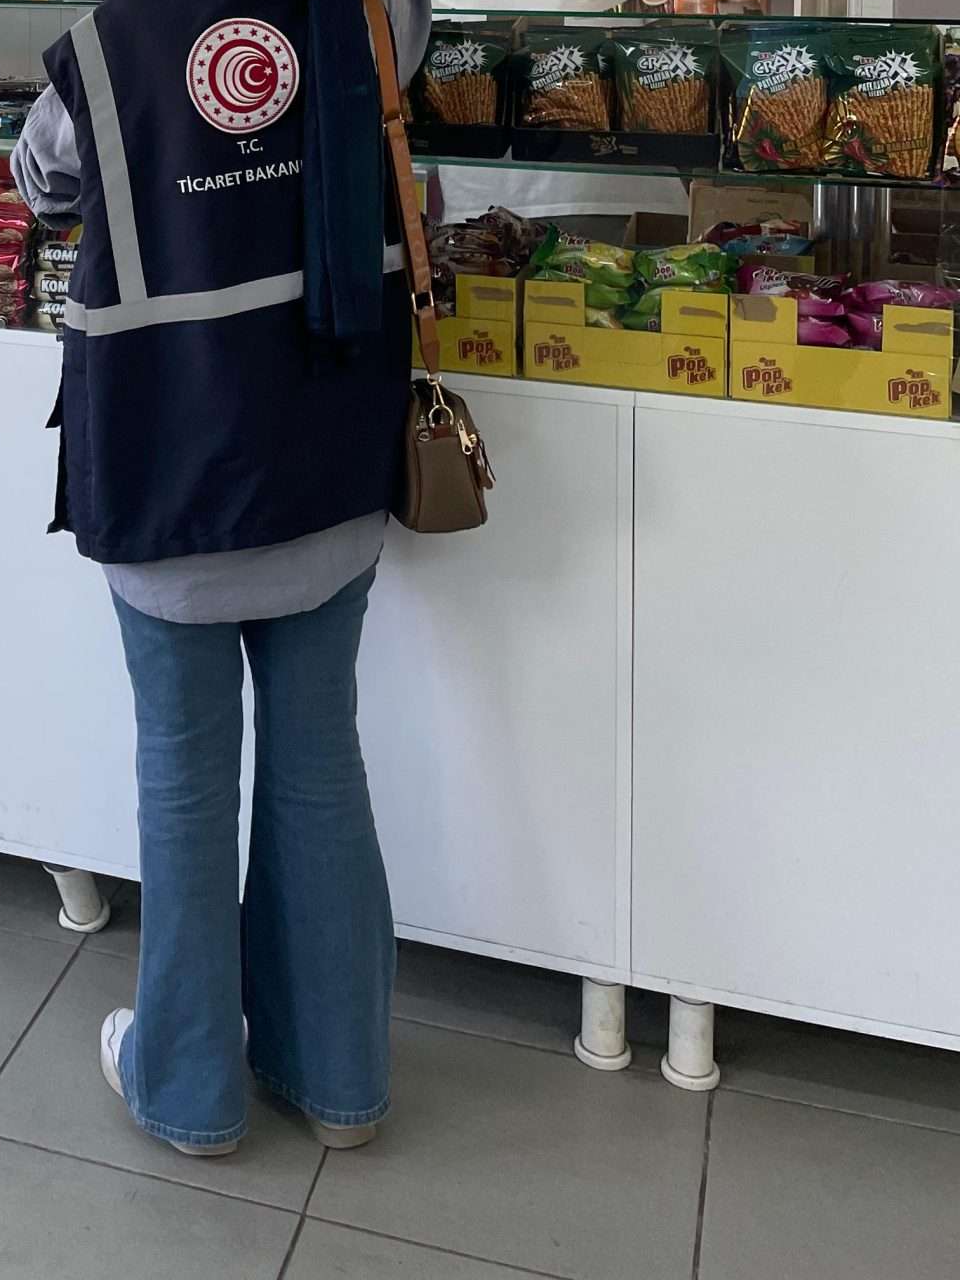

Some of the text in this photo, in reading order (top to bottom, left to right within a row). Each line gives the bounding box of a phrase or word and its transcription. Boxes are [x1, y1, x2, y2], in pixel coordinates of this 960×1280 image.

[237, 138, 264, 154] T.C.
[176, 170, 243, 194] TİCARET
[45, 250, 78, 266] KOM
[41, 279, 70, 294] KOM
